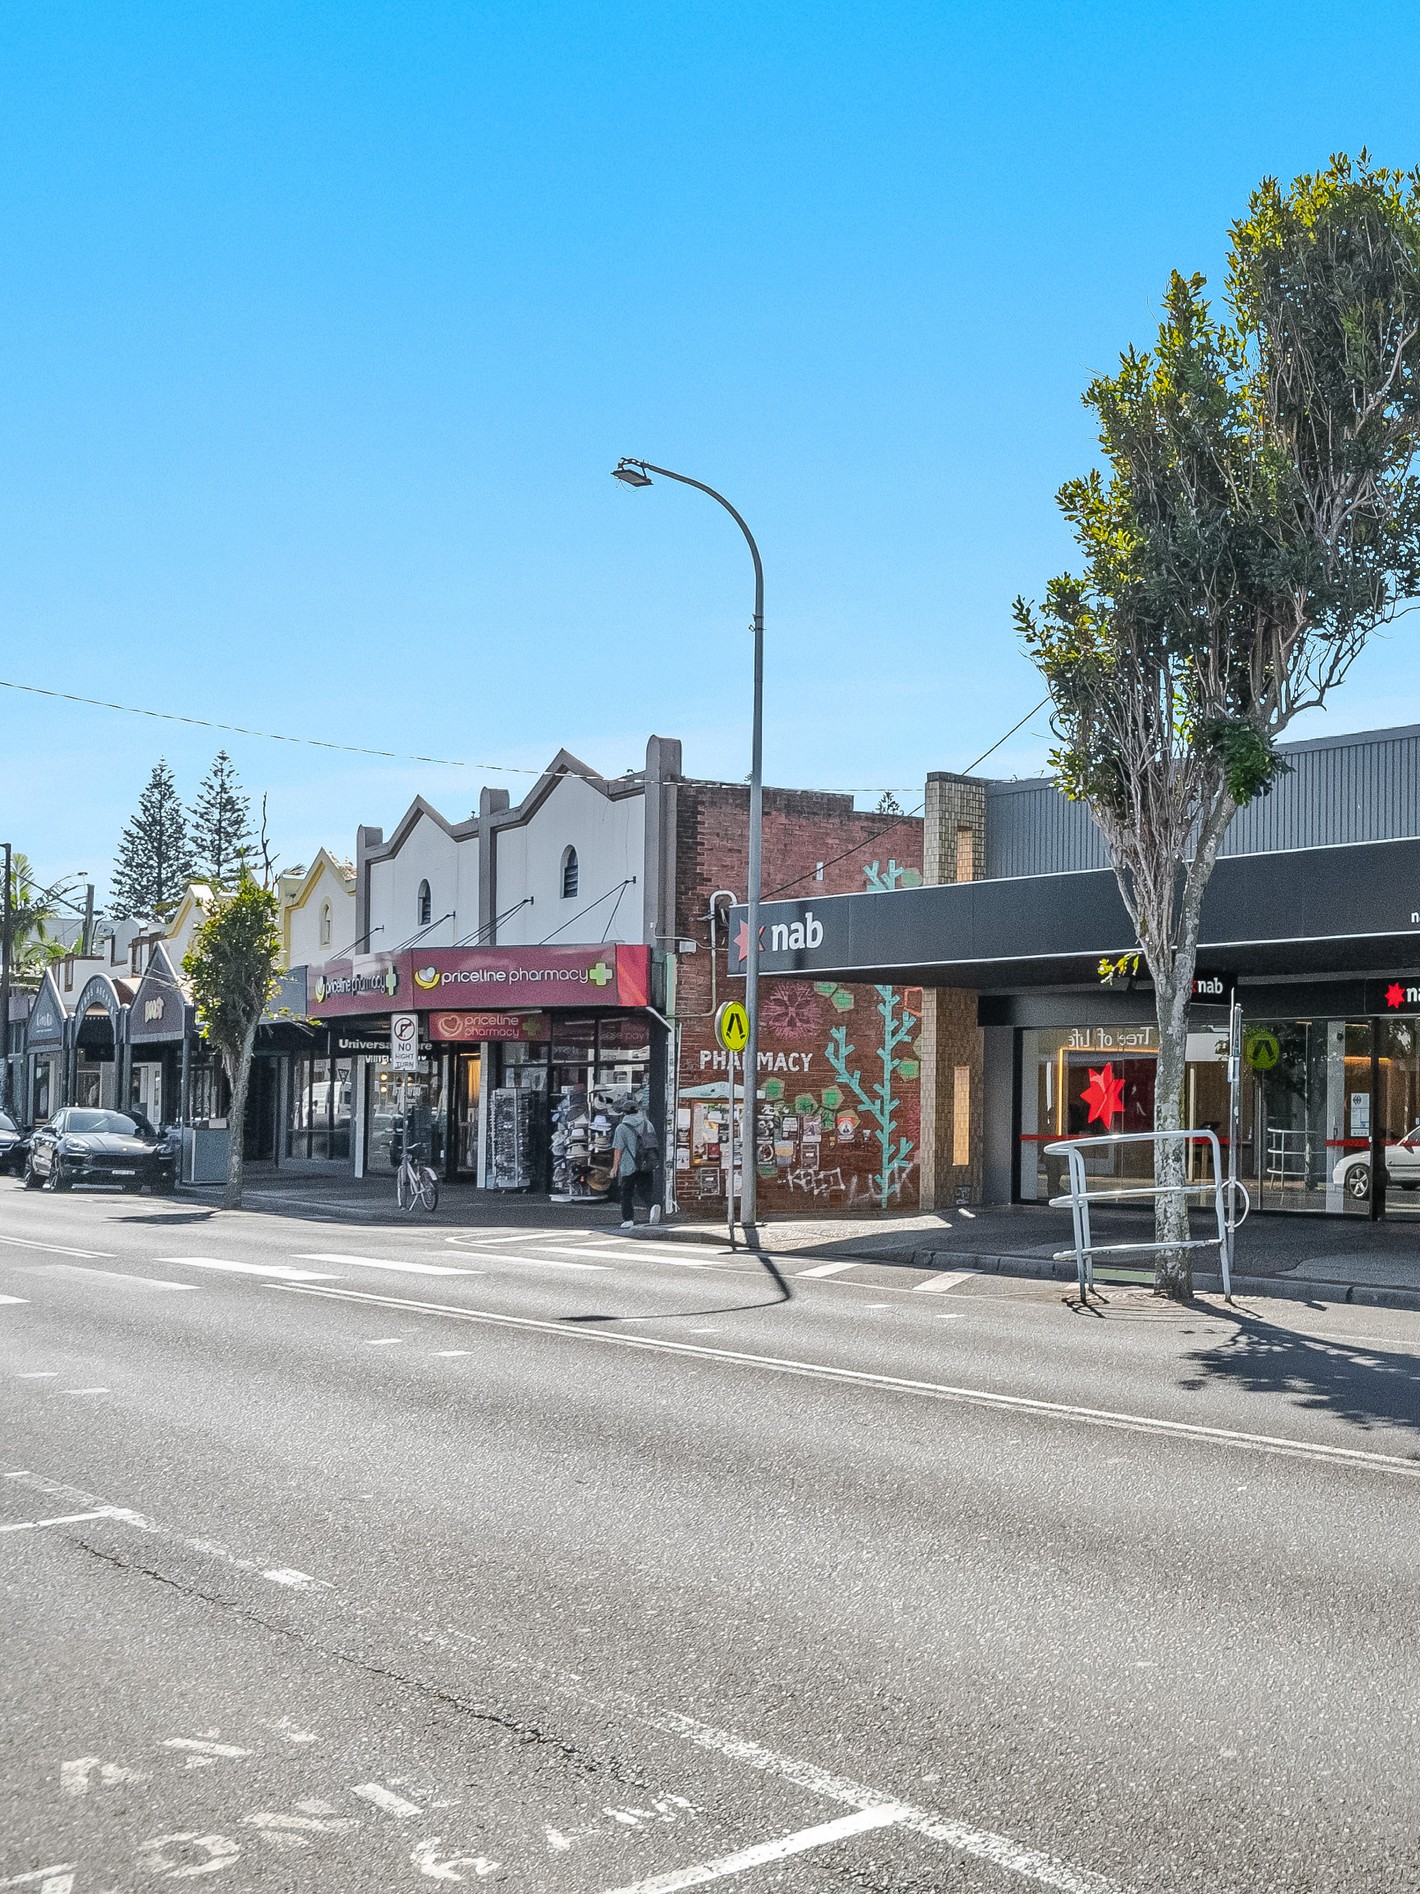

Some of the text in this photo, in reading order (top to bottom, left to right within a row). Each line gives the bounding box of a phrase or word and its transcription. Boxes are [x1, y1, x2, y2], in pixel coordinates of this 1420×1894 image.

[771, 912, 824, 952] nab
[441, 966, 589, 986] priceline pharmacy
[1197, 977, 1223, 995] nab
[463, 1015, 519, 1027] priceline
[463, 1026, 520, 1039] pharmacy
[338, 1039, 392, 1050] Universa
[398, 1043, 411, 1051] NO
[699, 1050, 813, 1073] PHAMACY
